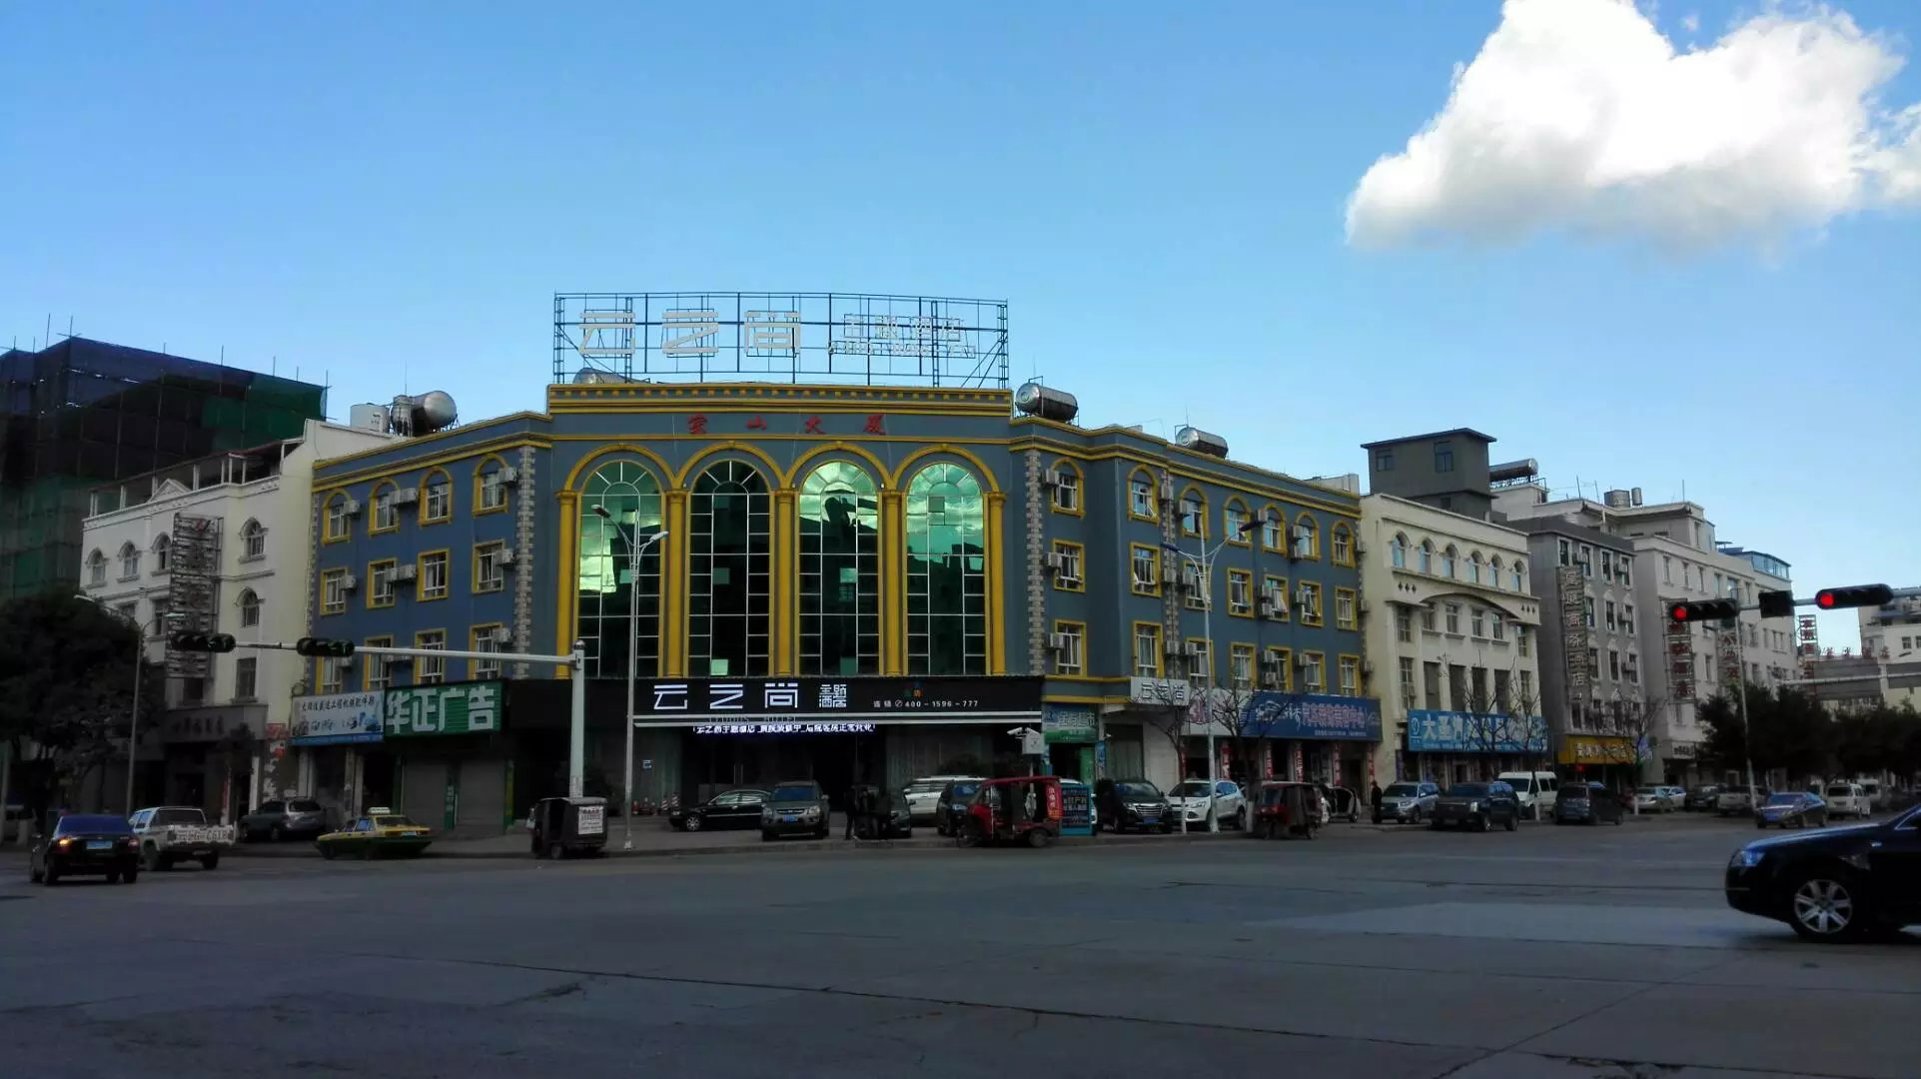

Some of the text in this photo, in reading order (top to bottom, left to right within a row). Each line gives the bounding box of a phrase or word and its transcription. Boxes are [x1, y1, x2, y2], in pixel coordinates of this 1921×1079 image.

[579, 310, 801, 355] 云之尚
[386, 685, 495, 734] 华正广告
[654, 683, 798, 710] 云之尚
